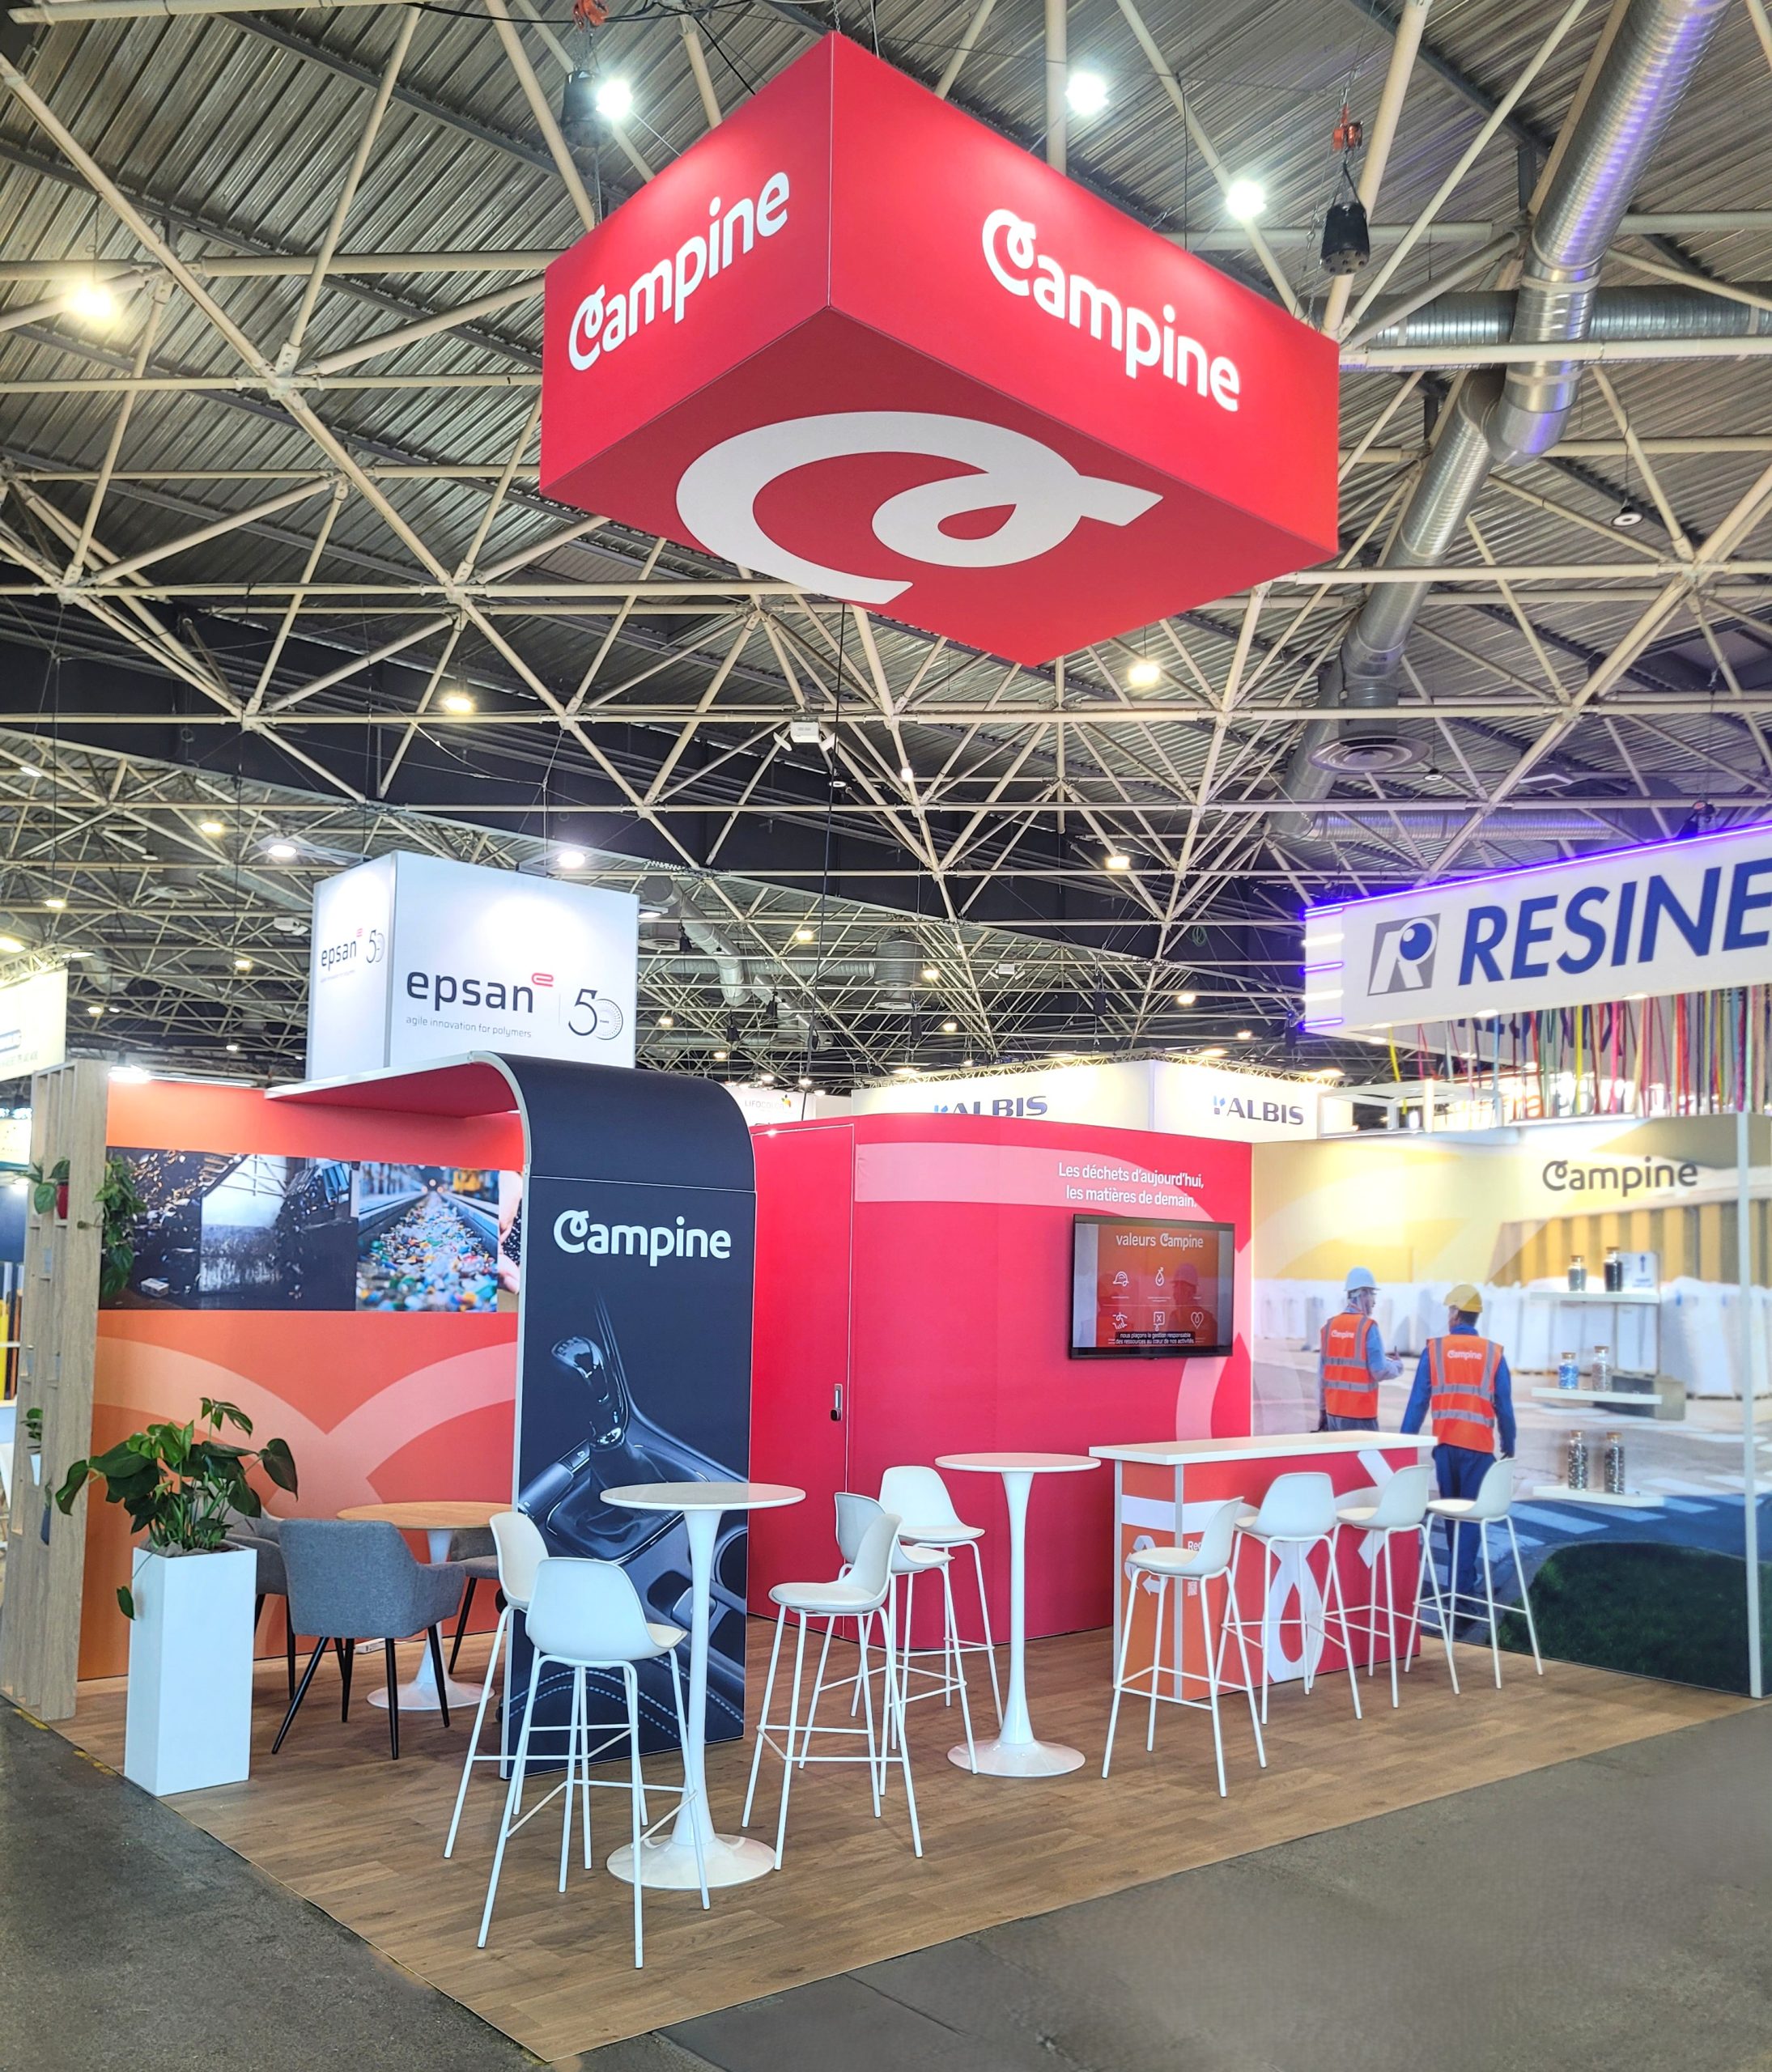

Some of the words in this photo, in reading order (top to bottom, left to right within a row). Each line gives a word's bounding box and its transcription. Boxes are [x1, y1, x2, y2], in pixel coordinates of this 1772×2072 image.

[569, 172, 790, 371] Campine
[982, 209, 1240, 412] Campine
[1458, 857, 1772, 986] RESINE
[321, 940, 356, 971] epsan
[406, 971, 533, 1013] epsan
[406, 1017, 428, 1027] agile
[430, 1018, 477, 1032] innovation
[478, 1023, 491, 1033] for
[492, 1026, 532, 1038] polymers
[1226, 1098, 1304, 1125] ALBIS
[1059, 1162, 1080, 1178] Les
[1082, 1165, 1129, 1181] déchets
[1132, 1168, 1204, 1189] d'aujourd'hui,
[1542, 1156, 1698, 1197] Campine
[1066, 1185, 1083, 1199] les
[1086, 1187, 1137, 1203] matières
[1138, 1190, 1153, 1204] de
[553, 1209, 732, 1267] Campine
[1115, 1232, 1157, 1246] valeurs
[1160, 1233, 1204, 1251] Campine
[1447, 1349, 1482, 1361] Campine
